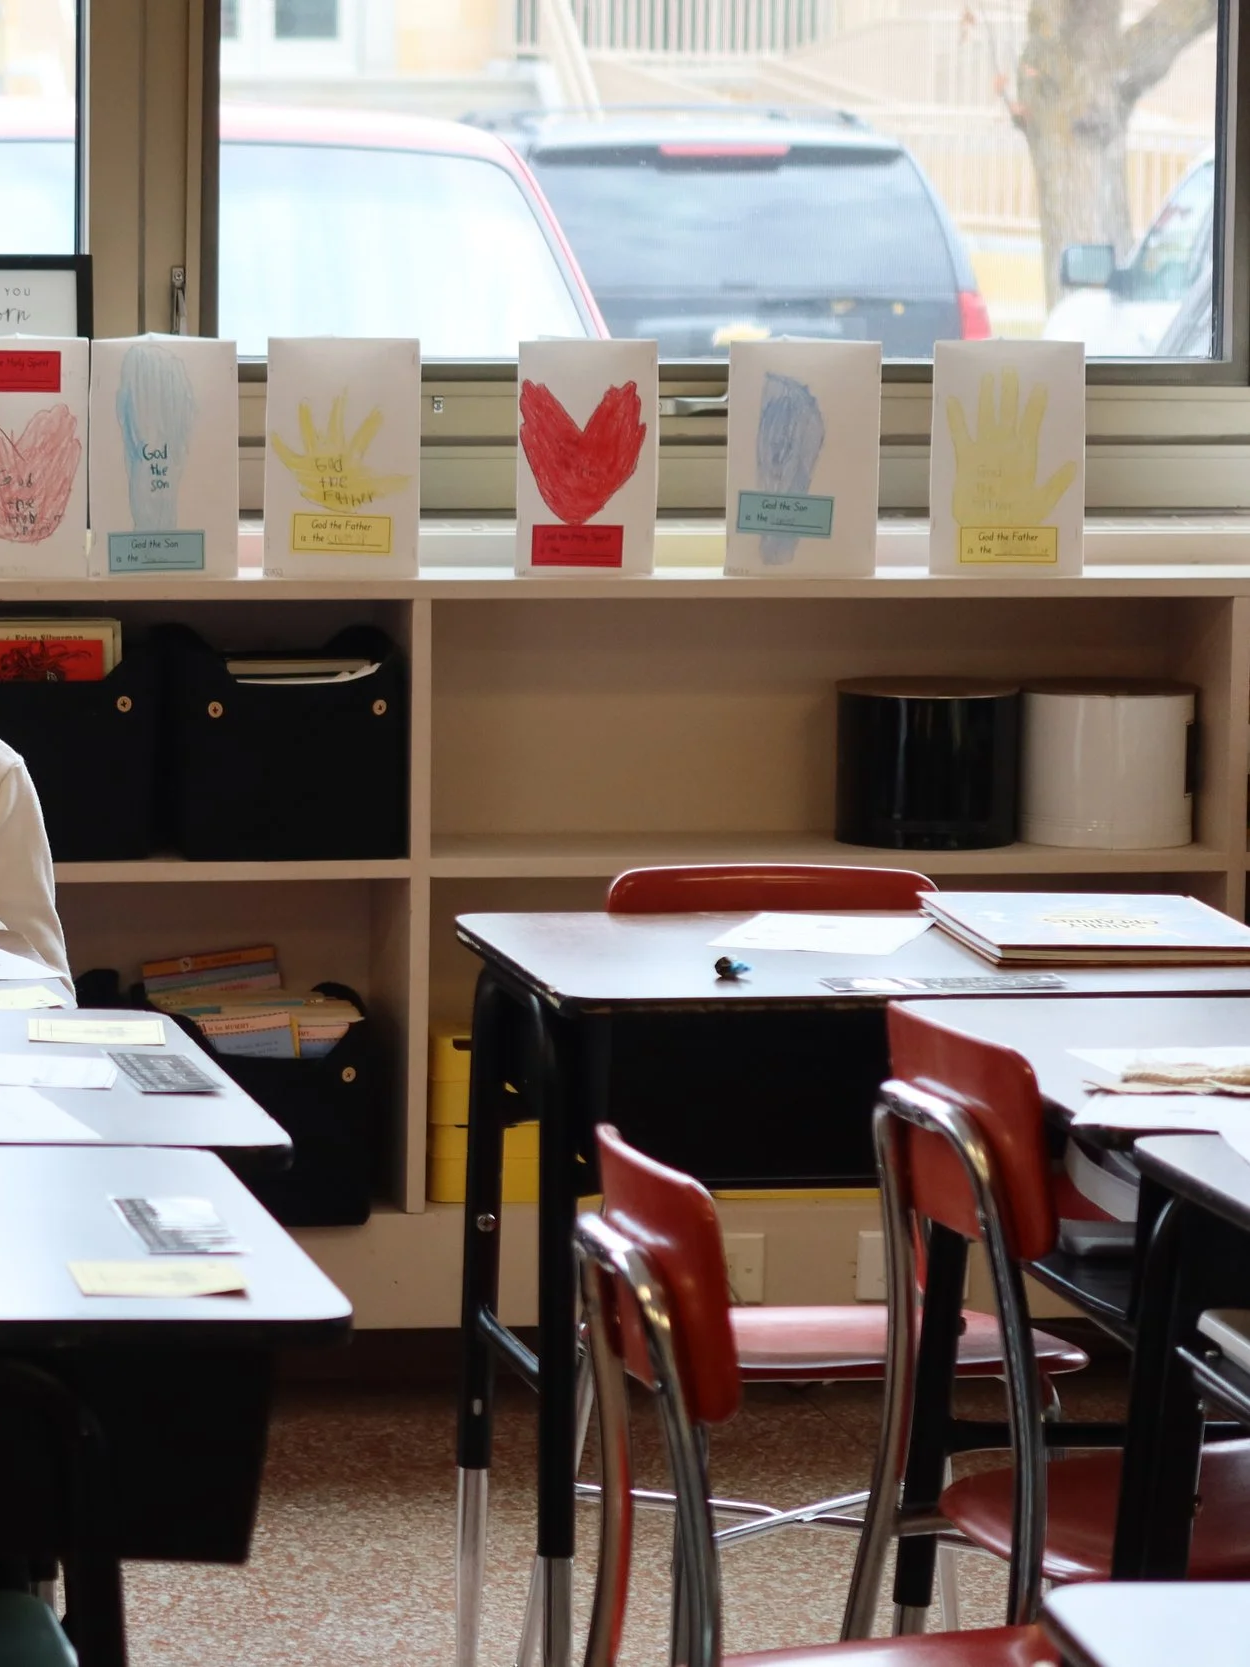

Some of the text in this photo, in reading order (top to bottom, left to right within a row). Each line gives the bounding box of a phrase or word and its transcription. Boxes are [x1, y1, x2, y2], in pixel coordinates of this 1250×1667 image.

[4, 287, 31, 297] YOU
[142, 443, 168, 461] God
[762, 499, 808, 512] God the Son
[756, 512, 768, 522] the
[311, 519, 372, 531] God the Father
[312, 533, 324, 542] the
[978, 532, 1038, 541] God the Father
[131, 538, 179, 549] God the Son
[980, 545, 992, 554] the
[127, 554, 138, 563] the
